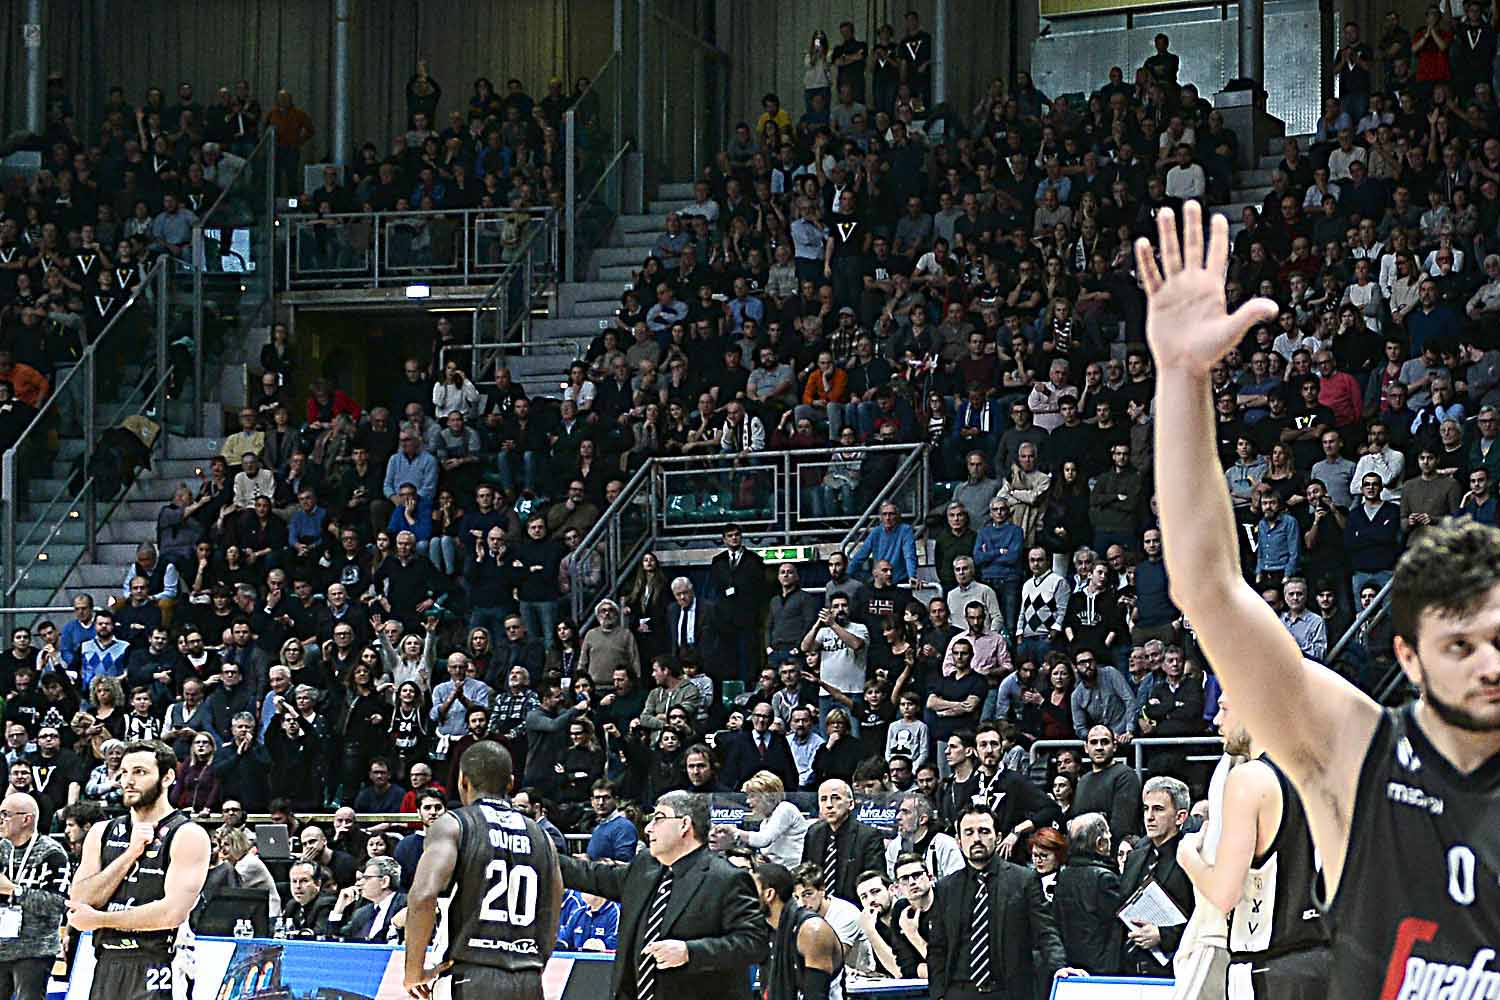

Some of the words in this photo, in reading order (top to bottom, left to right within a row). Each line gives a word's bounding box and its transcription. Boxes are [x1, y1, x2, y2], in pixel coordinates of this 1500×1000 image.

[399, 721, 412, 732] 24
[479, 858, 539, 928] 20
[1448, 845, 1476, 906] 0
[146, 967, 172, 991] 22
